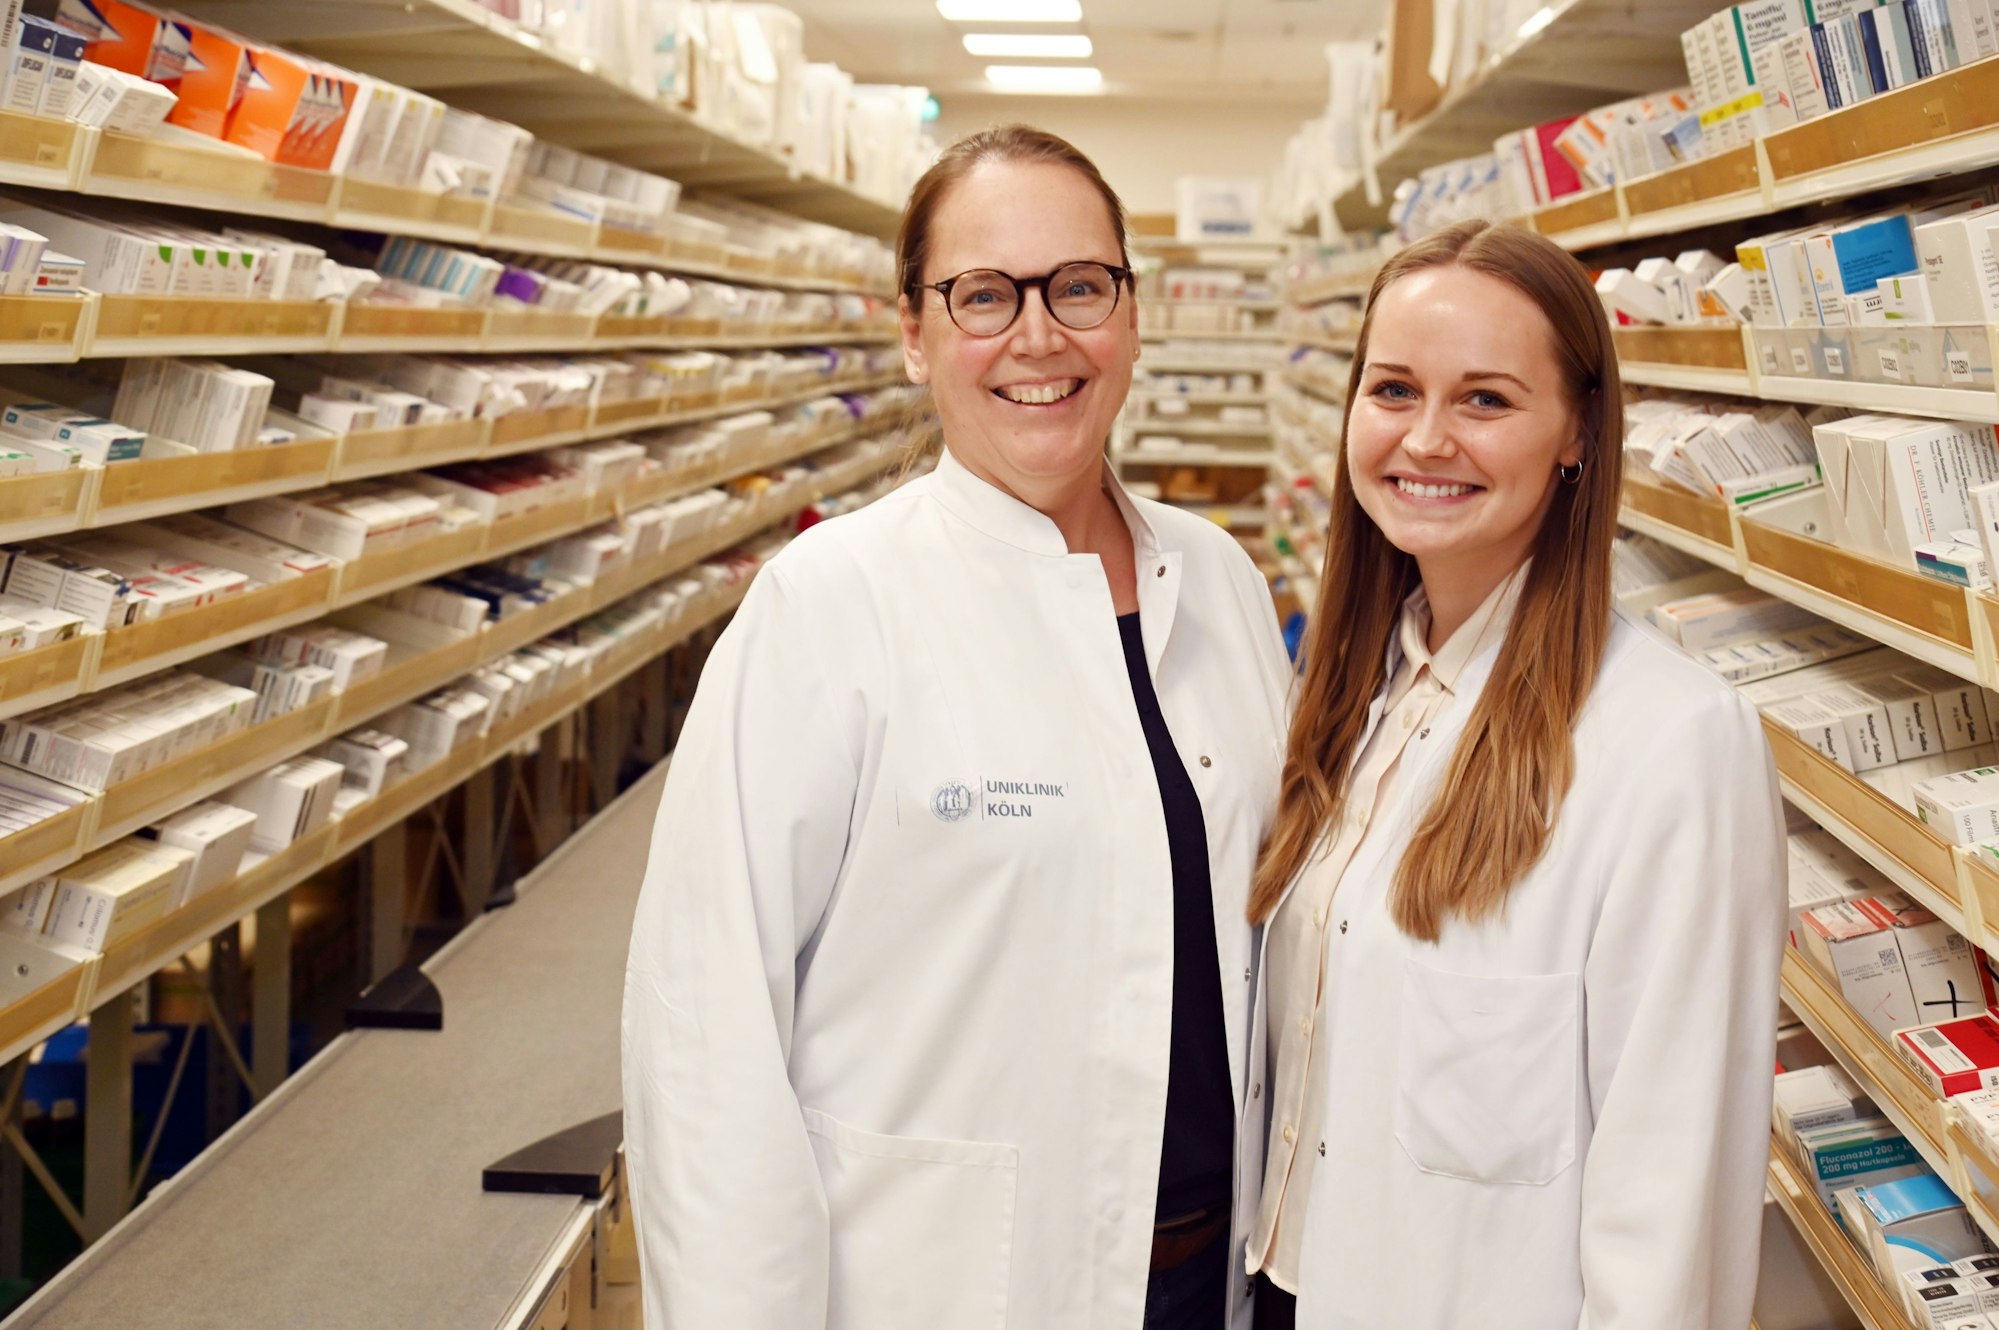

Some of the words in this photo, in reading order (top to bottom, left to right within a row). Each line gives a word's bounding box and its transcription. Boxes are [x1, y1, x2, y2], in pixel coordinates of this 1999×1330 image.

[1746, 22, 1754, 31] 6
[1915, 468, 1930, 500] KÖHLER
[1922, 501, 1936, 533] CHEMIE
[986, 780, 1065, 797] UNIKLINIK
[987, 801, 1032, 817] KÖLN
[1820, 1148, 1873, 1165] Fluconazol
[1875, 1145, 1893, 1154] 200
[1823, 1163, 1840, 1174] 200
[1843, 1162, 1858, 1170] mg
